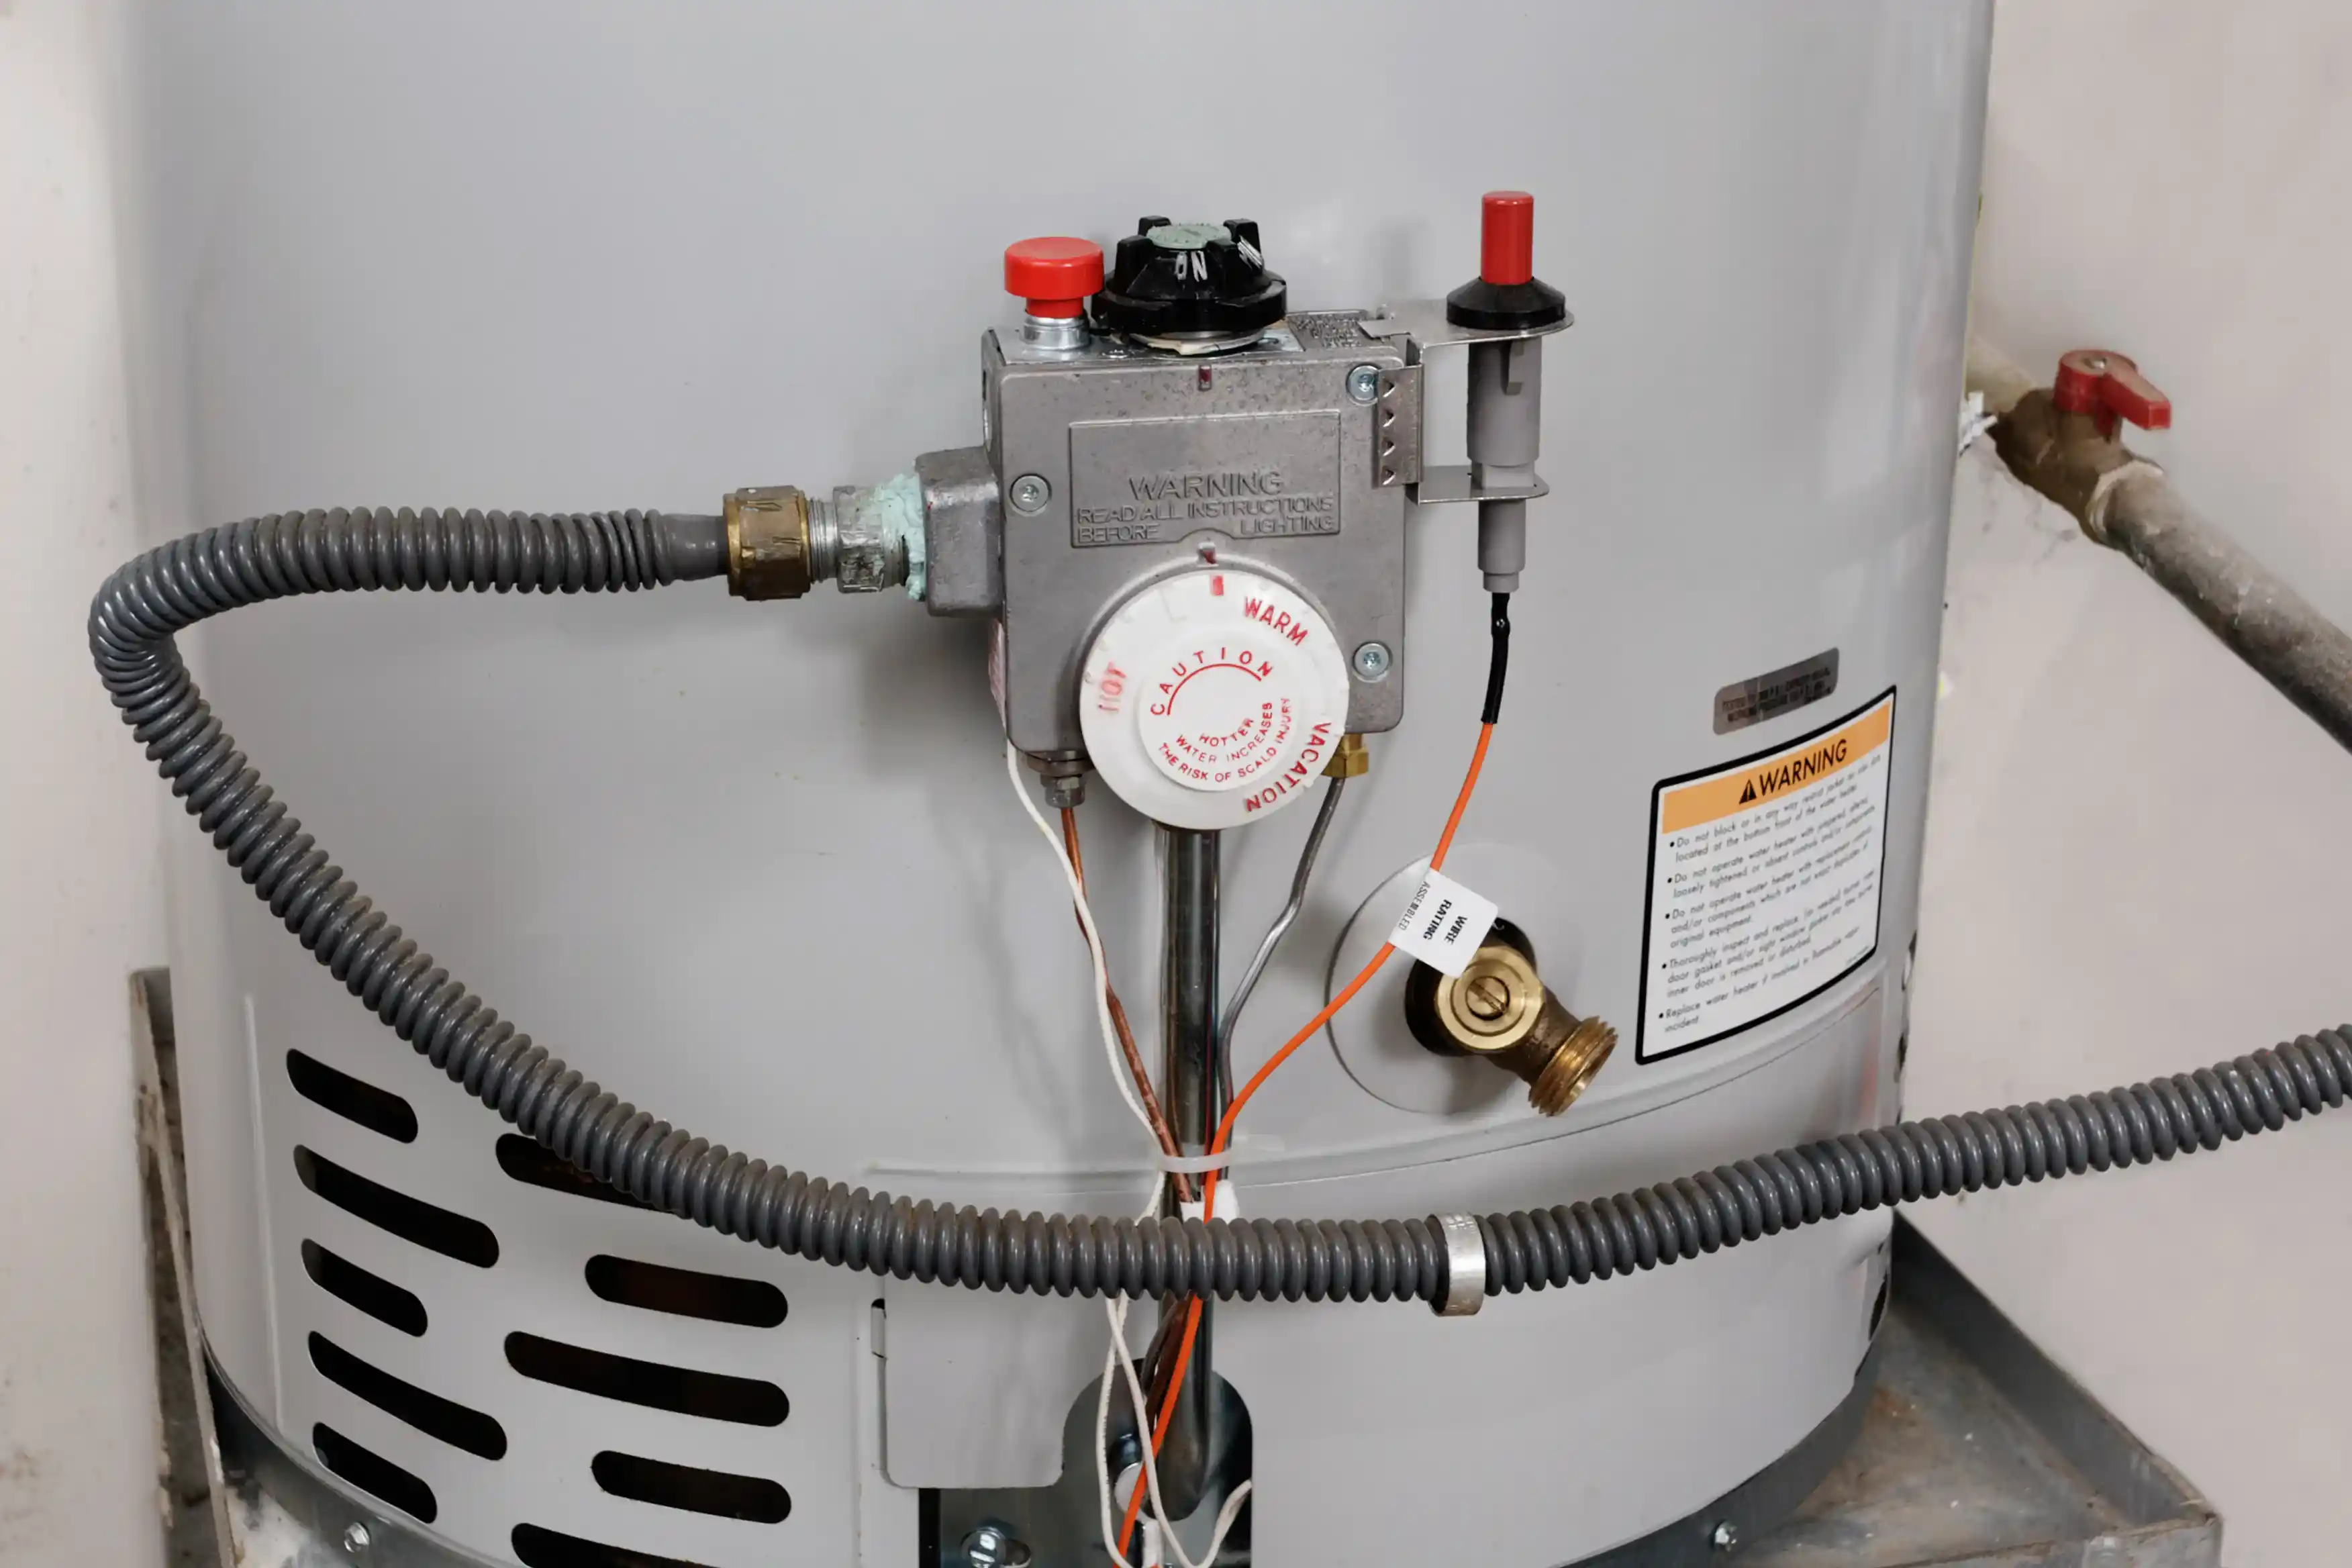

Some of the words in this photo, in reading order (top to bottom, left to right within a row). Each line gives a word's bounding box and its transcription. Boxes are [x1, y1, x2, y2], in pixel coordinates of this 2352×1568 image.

[1175, 250, 1208, 283] ON
[1129, 471, 1285, 501] WARNING
[1076, 507, 1135, 524] READ
[1142, 502, 1183, 522] ALL
[1187, 495, 1334, 518] INSTRUCTIONS
[1077, 523, 1161, 542] BEFORE
[1240, 514, 1334, 536] LIGHTING
[1243, 596, 1309, 648] WARM
[1150, 646, 1275, 717] CAUTION
[1158, 742, 1179, 767] THE
[1178, 763, 1208, 781] RISK
[1214, 771, 1232, 783] OF
[1238, 746, 1277, 779] SCALD
[1277, 697, 1293, 746] INJURY
[1175, 734, 1218, 764] WATER
[1226, 701, 1273, 763] INCREASES
[1199, 718, 1255, 747] HOTTER
[1245, 721, 1332, 813] VACATION
[1759, 738, 1847, 796] WARNING
[1675, 843, 1709, 863] located
[1726, 837, 1739, 847] the
[1743, 826, 1771, 842] bottom
[1677, 836, 1689, 848] Do
[1695, 830, 1710, 842] not
[1714, 821, 1736, 838] block
[1673, 882, 1704, 898] loosely
[1709, 867, 1747, 889] tightened
[1752, 865, 1760, 873] or
[1674, 873, 1687, 884] Do
[1692, 867, 1707, 878] not
[1712, 856, 1744, 873] operate
[1749, 846, 1770, 859] water
[1398, 881, 1431, 931] ASSEMBLED
[1671, 918, 1703, 934] and/or
[1708, 900, 1756, 923] components
[1672, 908, 1685, 920] Do
[1690, 902, 1705, 914] not
[1709, 891, 1742, 910] operate
[1746, 881, 1768, 895] water
[1423, 899, 1453, 940] RATING
[1444, 915, 1469, 945] WIRE
[1669, 947, 1717, 969] Thoroughly
[1722, 935, 1750, 952] inspect
[1753, 926, 1769, 941] and
[1670, 929, 1704, 948] original
[1667, 971, 1689, 984] door
[1694, 959, 1722, 979] gasket
[1667, 986, 1689, 997] inner
[1694, 977, 1715, 990] door
[1730, 958, 1764, 977] removed
[1665, 1003, 1701, 1018] Replace
[1706, 993, 1728, 1006] water
[1733, 981, 1759, 995] heater
